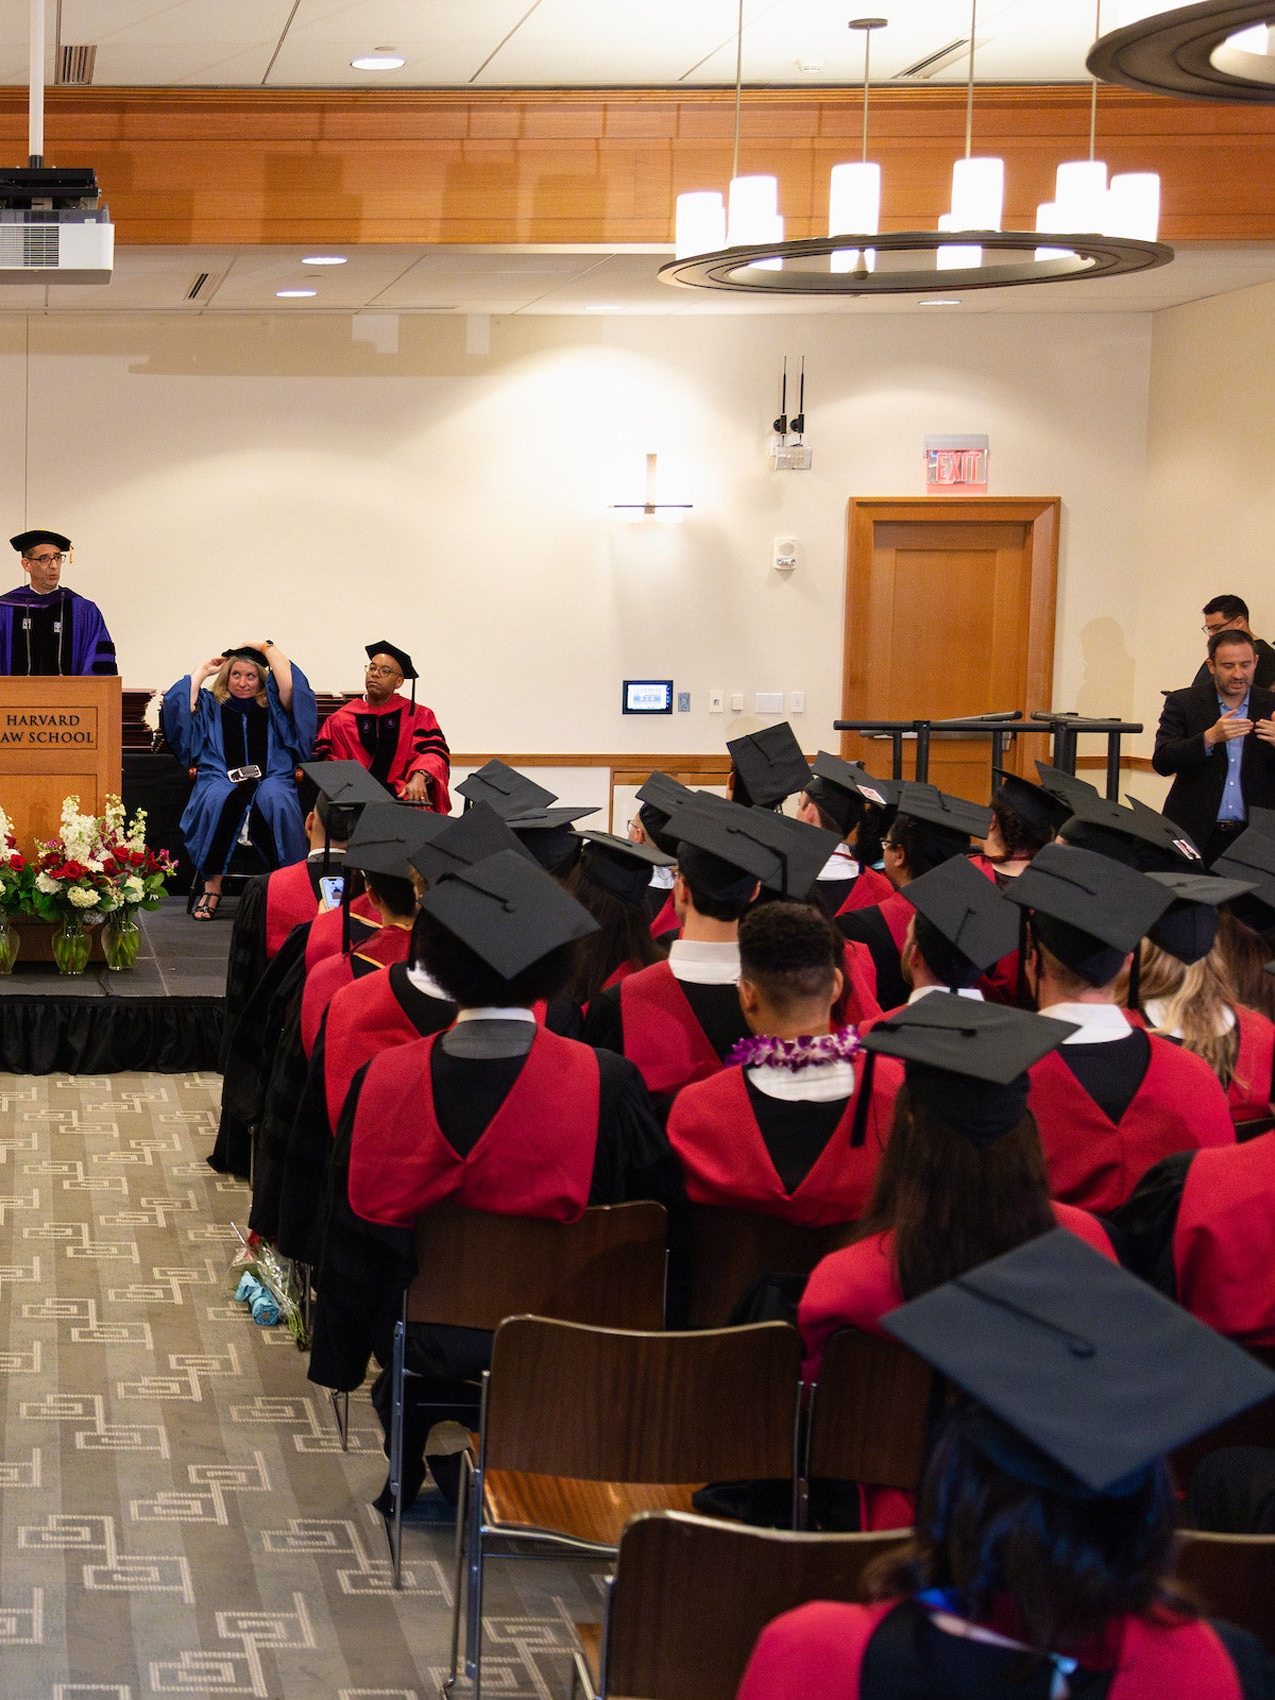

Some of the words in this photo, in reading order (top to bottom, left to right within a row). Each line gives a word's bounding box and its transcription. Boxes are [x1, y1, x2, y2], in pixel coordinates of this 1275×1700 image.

[936, 451, 982, 481] EXIT
[6, 714, 81, 727] HARVARD
[28, 731, 94, 743] SCHOOL
